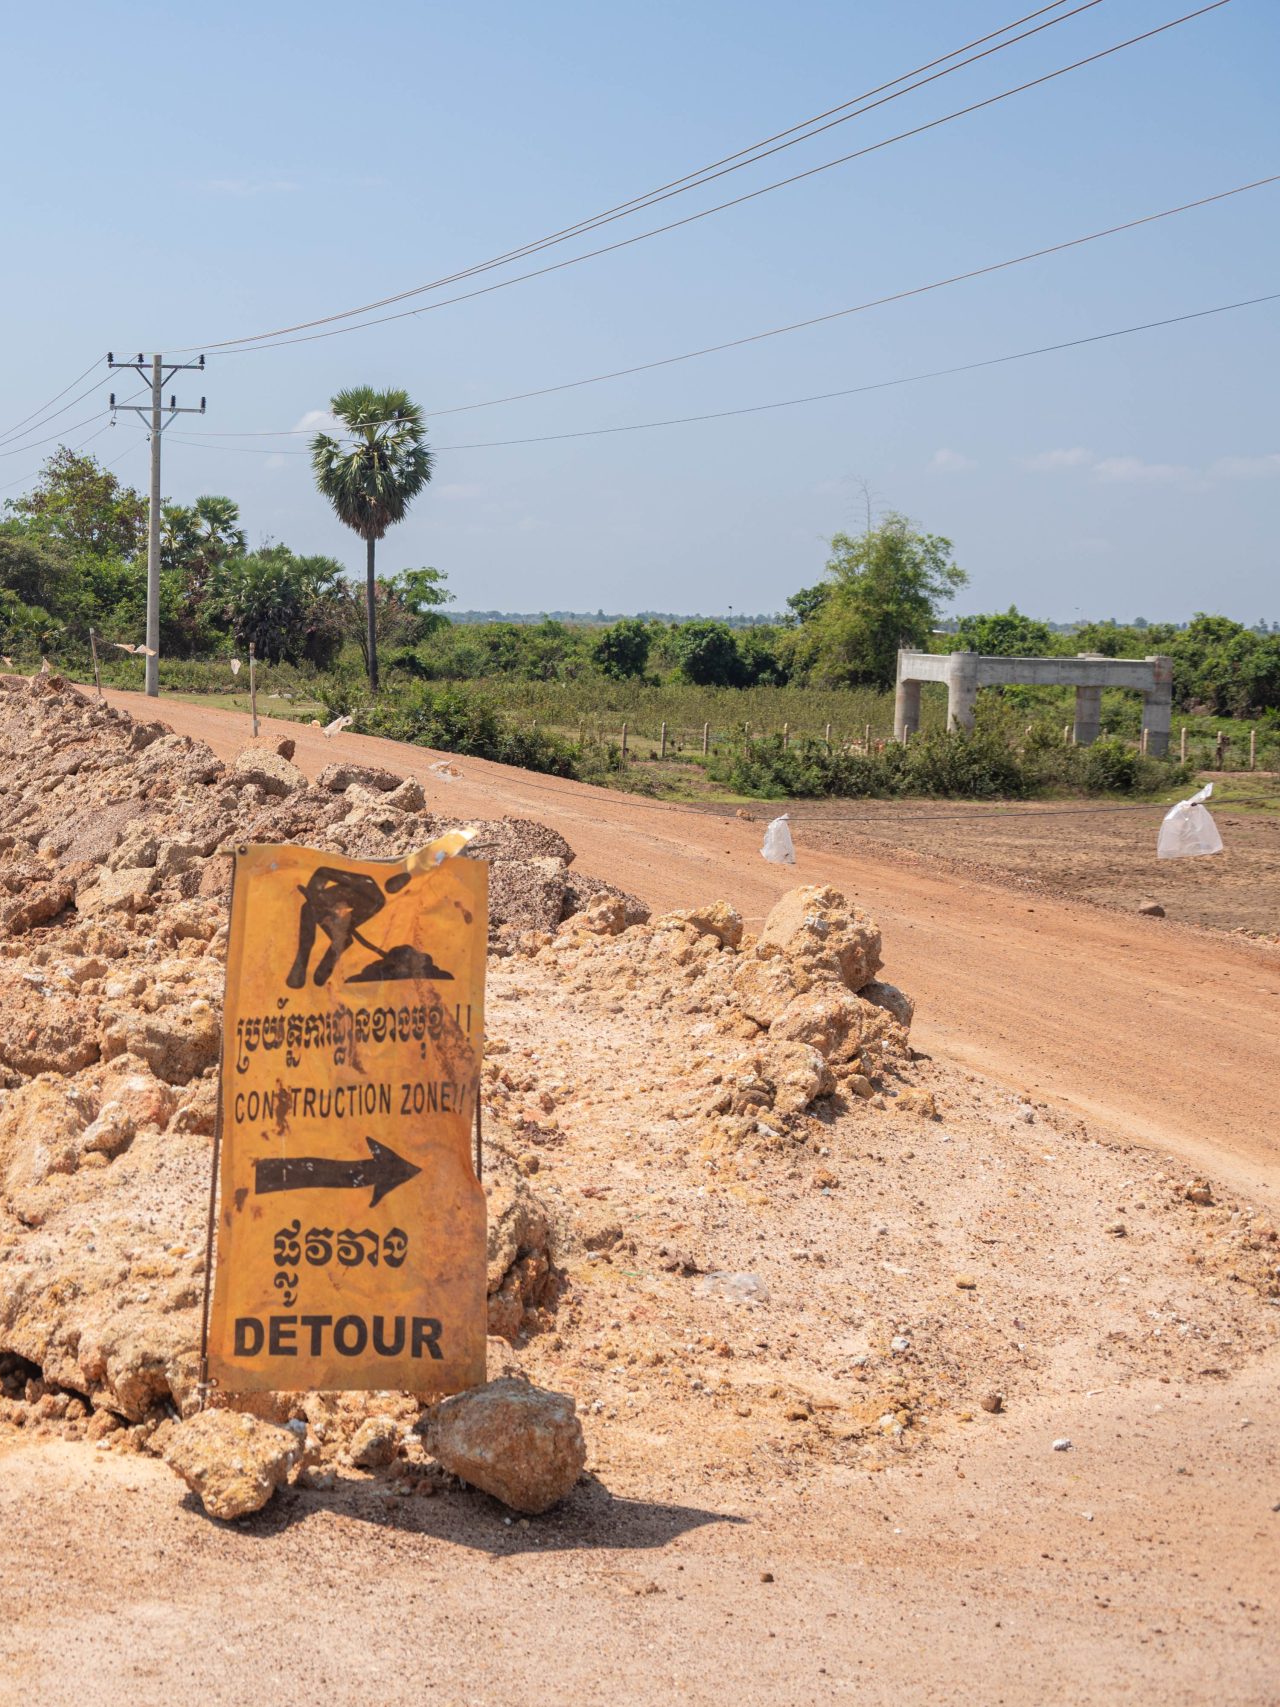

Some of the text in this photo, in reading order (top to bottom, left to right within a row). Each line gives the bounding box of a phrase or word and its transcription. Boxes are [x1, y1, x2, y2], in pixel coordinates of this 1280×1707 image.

[273, 1219, 409, 1308] ផ្លូវវាង
[233, 1314, 444, 1360] DETOUR
